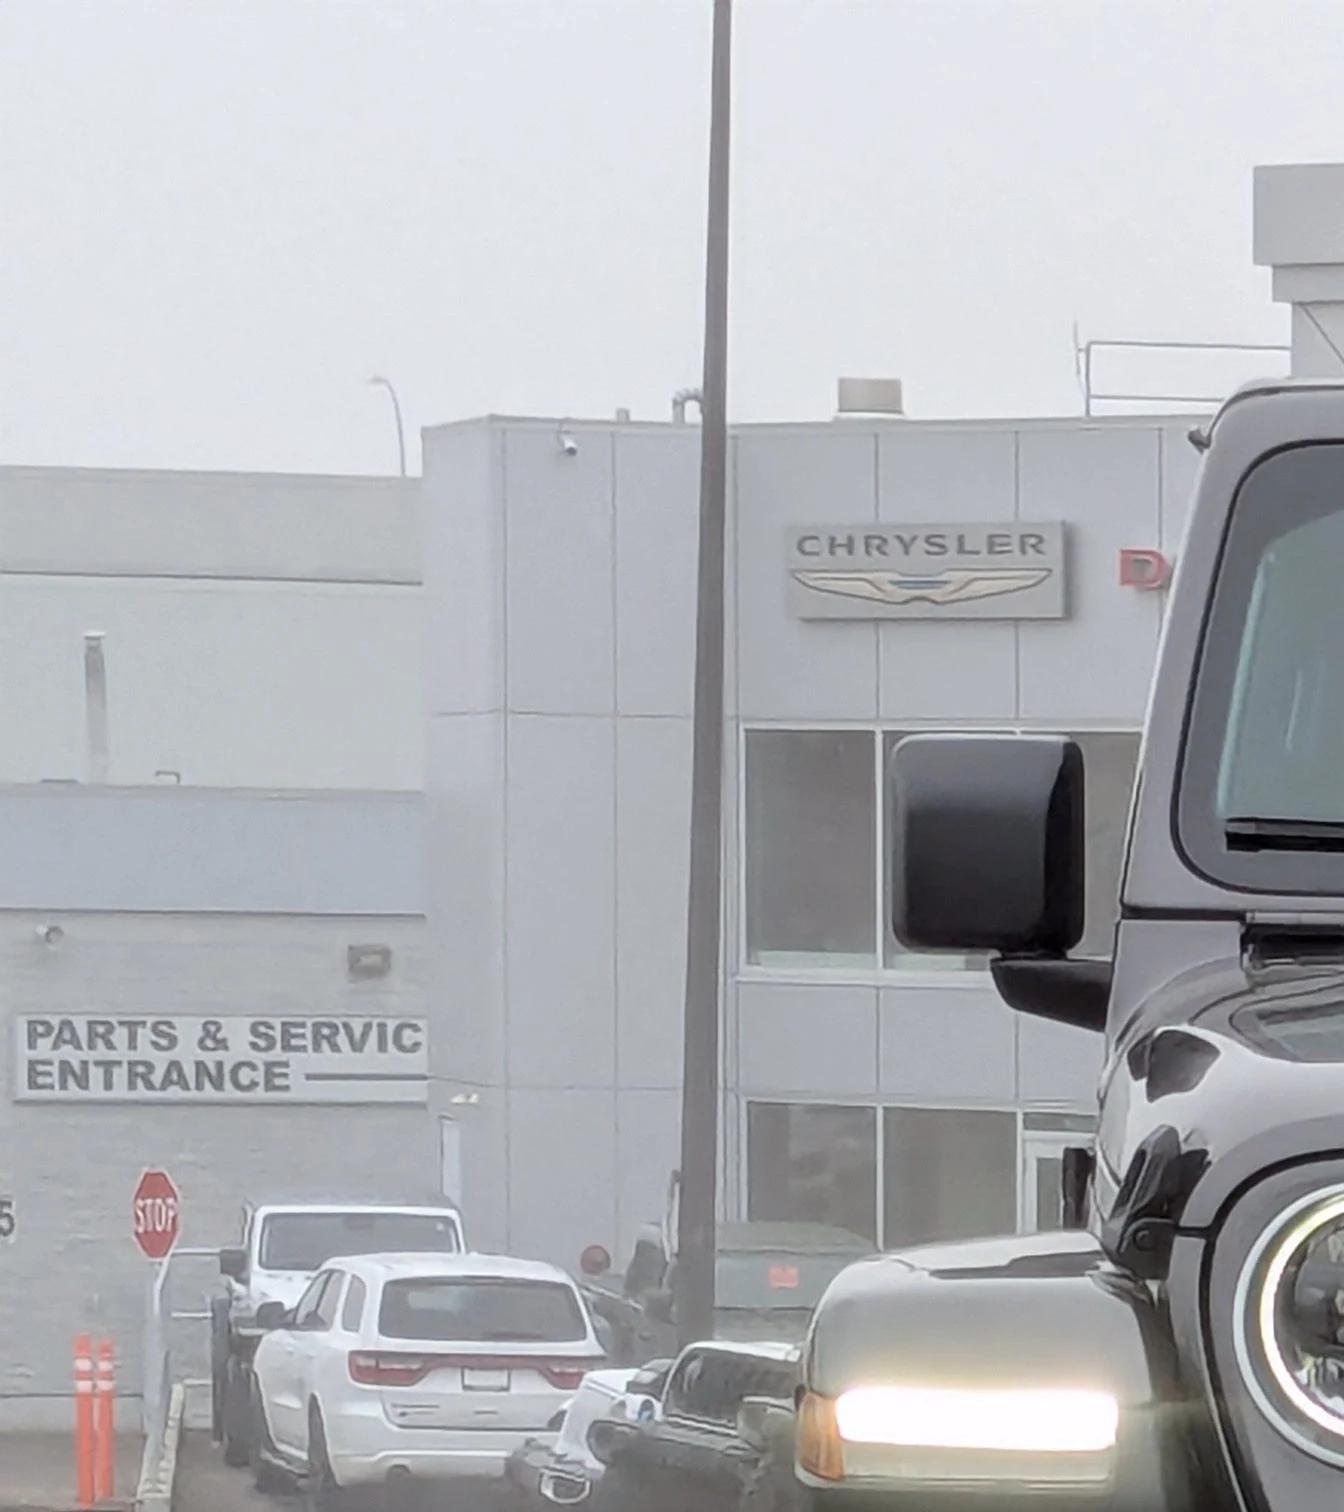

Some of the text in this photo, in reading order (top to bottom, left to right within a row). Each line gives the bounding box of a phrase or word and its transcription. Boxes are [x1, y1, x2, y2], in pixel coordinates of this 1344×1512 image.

[796, 533, 1047, 556] CHRYSLER
[26, 1019, 423, 1054] PARTS & SERVIC
[27, 1059, 291, 1093] ENTRANCE
[135, 1198, 177, 1233] STOP
